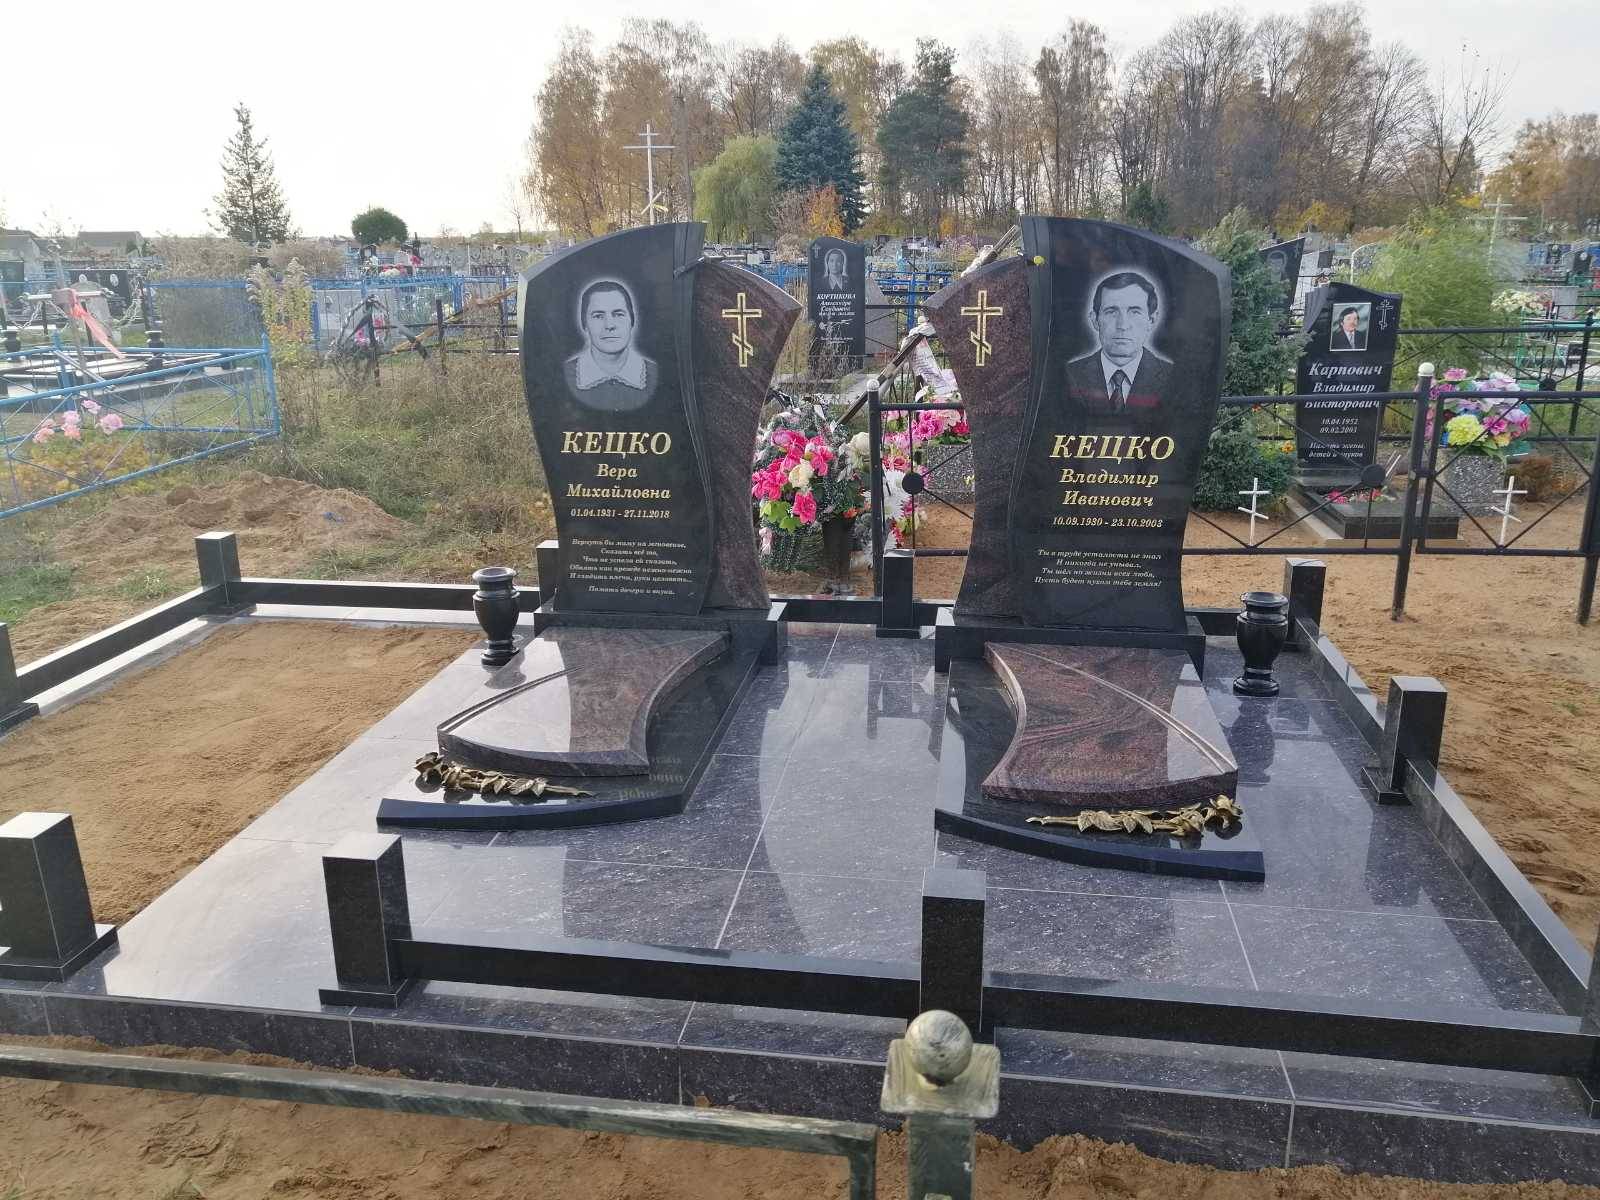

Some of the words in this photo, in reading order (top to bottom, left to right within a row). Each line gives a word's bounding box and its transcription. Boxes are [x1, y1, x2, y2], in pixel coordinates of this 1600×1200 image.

[1309, 363, 1383, 379] Карпович
[1313, 382, 1375, 394] Владимир
[560, 432, 672, 459] КЕЦКО
[1049, 434, 1175, 464] КЕЦКО
[597, 464, 638, 480] Вера
[1059, 468, 1159, 488] Владимир
[566, 483, 672, 499] Михайловна
[1062, 490, 1154, 507] Иванович
